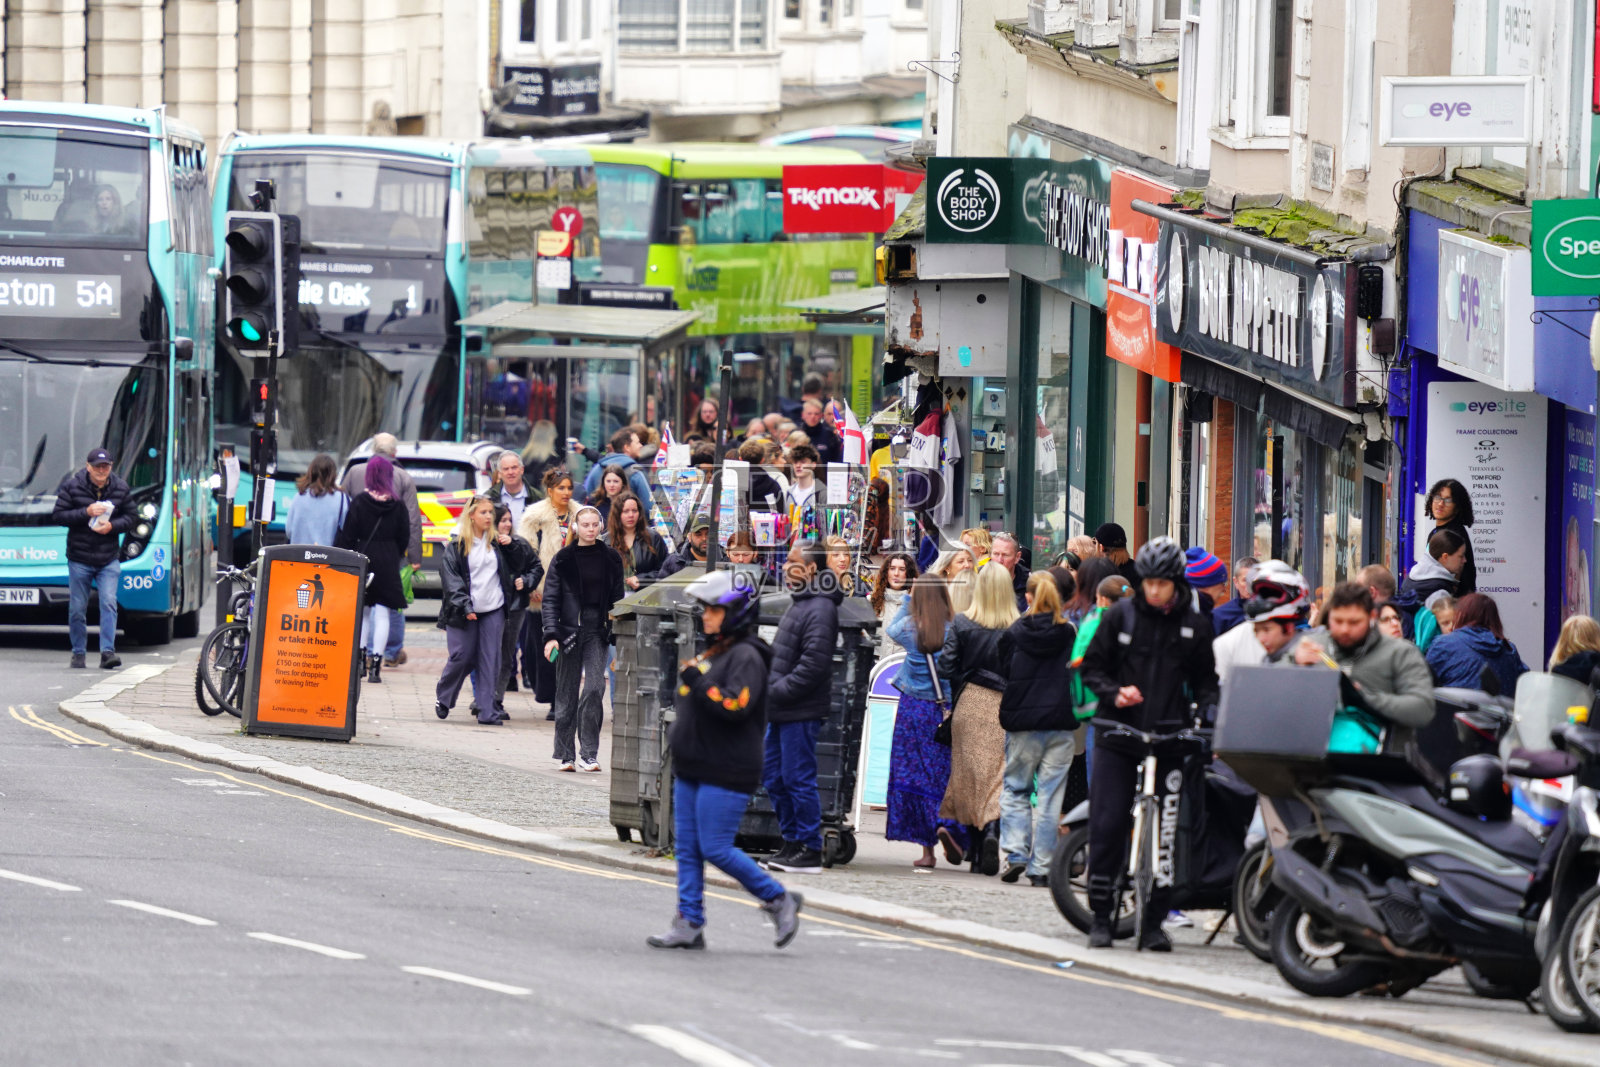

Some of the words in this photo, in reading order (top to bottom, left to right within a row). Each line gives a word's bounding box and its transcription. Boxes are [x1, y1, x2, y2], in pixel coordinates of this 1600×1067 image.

[958, 186, 980, 197] THE
[950, 197, 988, 209] BODY
[951, 209, 987, 221] SHOP
[1045, 182, 1061, 248] THE
[1060, 188, 1087, 260] BODY
[559, 213, 576, 232] Y
[0, 255, 65, 268] CHARLOTTE
[76, 280, 113, 308] 5A
[328, 281, 371, 306] Oak
[405, 284, 417, 309] 1
[1198, 244, 1230, 343] BON
[1468, 398, 1527, 416] eyesite
[123, 576, 153, 590] 306
[10, 591, 33, 602] NVR
[281, 614, 311, 633] Bin
[315, 616, 329, 635] it
[279, 634, 287, 642] or
[288, 634, 306, 645] take
[308, 636, 314, 645] it
[314, 637, 338, 647] home
[277, 649, 288, 657] We
[276, 659, 292, 667] £150
[301, 660, 312, 668] the
[313, 662, 327, 671] spot
[275, 668, 290, 676] fines
[291, 669, 300, 677] for
[300, 670, 329, 680] dropping
[281, 678, 304, 688] leaving
[304, 680, 320, 688] litter
